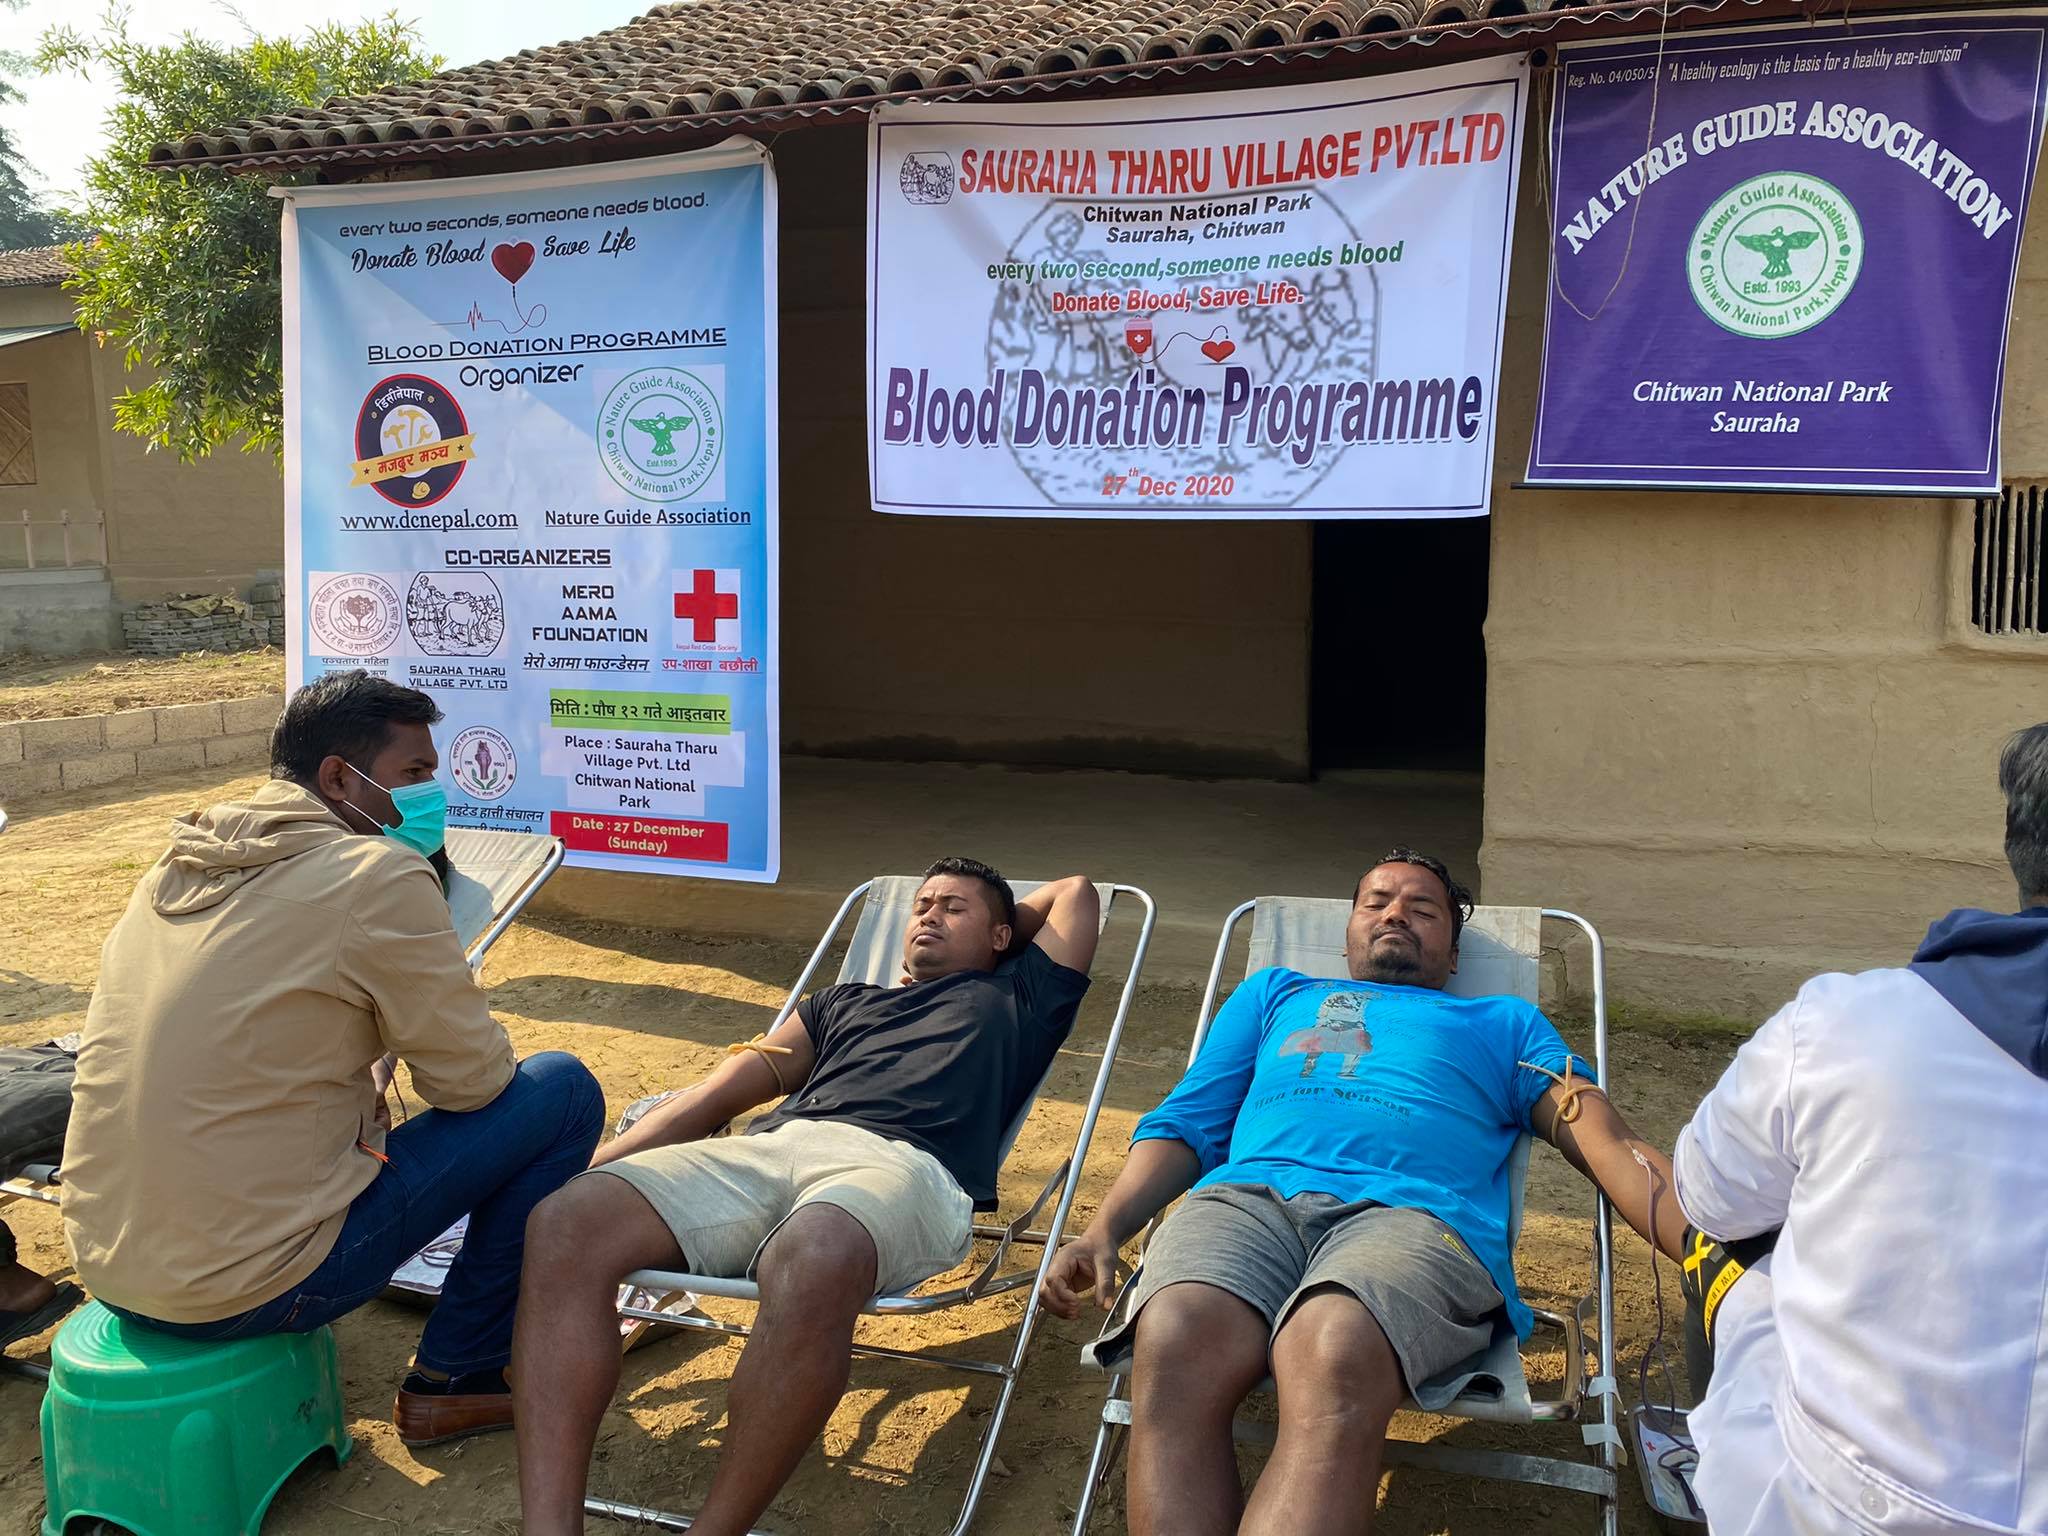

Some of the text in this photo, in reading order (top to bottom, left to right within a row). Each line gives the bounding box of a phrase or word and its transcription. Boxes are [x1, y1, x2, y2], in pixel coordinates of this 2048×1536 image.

[1681, 62, 1717, 82] healthy
[1720, 63, 1760, 80] ecology
[1762, 61, 1770, 75] is
[1774, 60, 1790, 73] the
[1794, 58, 1820, 72] basis
[1824, 56, 1841, 71] for
[1843, 57, 1849, 69] a
[1853, 52, 1892, 70] healthy
[1895, 43, 1968, 65] eco-tourism"
[1569, 66, 1658, 87] Reg. No. 04/050/5
[959, 113, 1505, 195] SAURAHA THARU VILLAGE PVT.LTD
[1561, 101, 2013, 255] NATURE GUIDE ASSOCIATION
[340, 193, 709, 237] every two seconds, someone needs blood.
[1083, 194, 1312, 223] Chitwan National Park
[1702, 182, 1848, 246] Nature Guide Association
[1106, 218, 1285, 244] Sauraha, Chitwan
[351, 227, 636, 272] Donate Blood Save Life
[986, 261, 1034, 284] every
[1040, 261, 1078, 278] two
[1266, 247, 1333, 270] needs
[1340, 242, 1403, 265] blood
[1700, 265, 1730, 312] Chitwan
[1732, 305, 1790, 326] National
[1744, 280, 1801, 294] Estd. 1993
[1052, 285, 1303, 314] Donate Blood, Save Life.
[368, 328, 726, 362] BLOOD DONATION PROGRAMME
[460, 362, 584, 391] Organizer
[605, 376, 712, 426] Nature Guide Association
[1633, 381, 1892, 402] Chitwan National Park
[884, 366, 1482, 466] Blood Donation Programme
[1711, 413, 1799, 433] Sauraha
[607, 442, 633, 481] Chitwan
[635, 475, 677, 493] National
[1138, 478, 1179, 496] Dec
[1184, 477, 1234, 496] 2020
[341, 509, 517, 532] www.dcnepal.com
[545, 508, 751, 526] Nature Guide Association
[445, 550, 610, 565] CO-ORGANIZERS
[562, 584, 614, 599] MERO
[562, 607, 617, 621] AAMA
[533, 627, 648, 642] FOUNDATION
[410, 666, 505, 676] SAURAHA THARU
[523, 653, 650, 671] मेरो आमा फाउन्डेसन
[662, 656, 759, 671] उप-शाखा बछौली
[409, 679, 508, 689] VILLAGE PVT. LTD
[550, 699, 581, 715] मिति
[622, 705, 637, 717] १२
[643, 704, 662, 718] गते
[667, 705, 726, 722] आइतबार
[564, 736, 602, 750] Place
[614, 737, 670, 753] Sauraha
[673, 741, 717, 756] Tharu
[585, 754, 690, 771] Village Pvt. Ltd
[575, 774, 695, 792] Chitwan National
[446, 803, 544, 821] नाइटेड हात्ती संचालन
[619, 794, 650, 809] Park
[573, 817, 602, 830] Date
[614, 821, 629, 832] 27
[633, 821, 704, 838] December
[607, 836, 667, 853] (Sunday)
